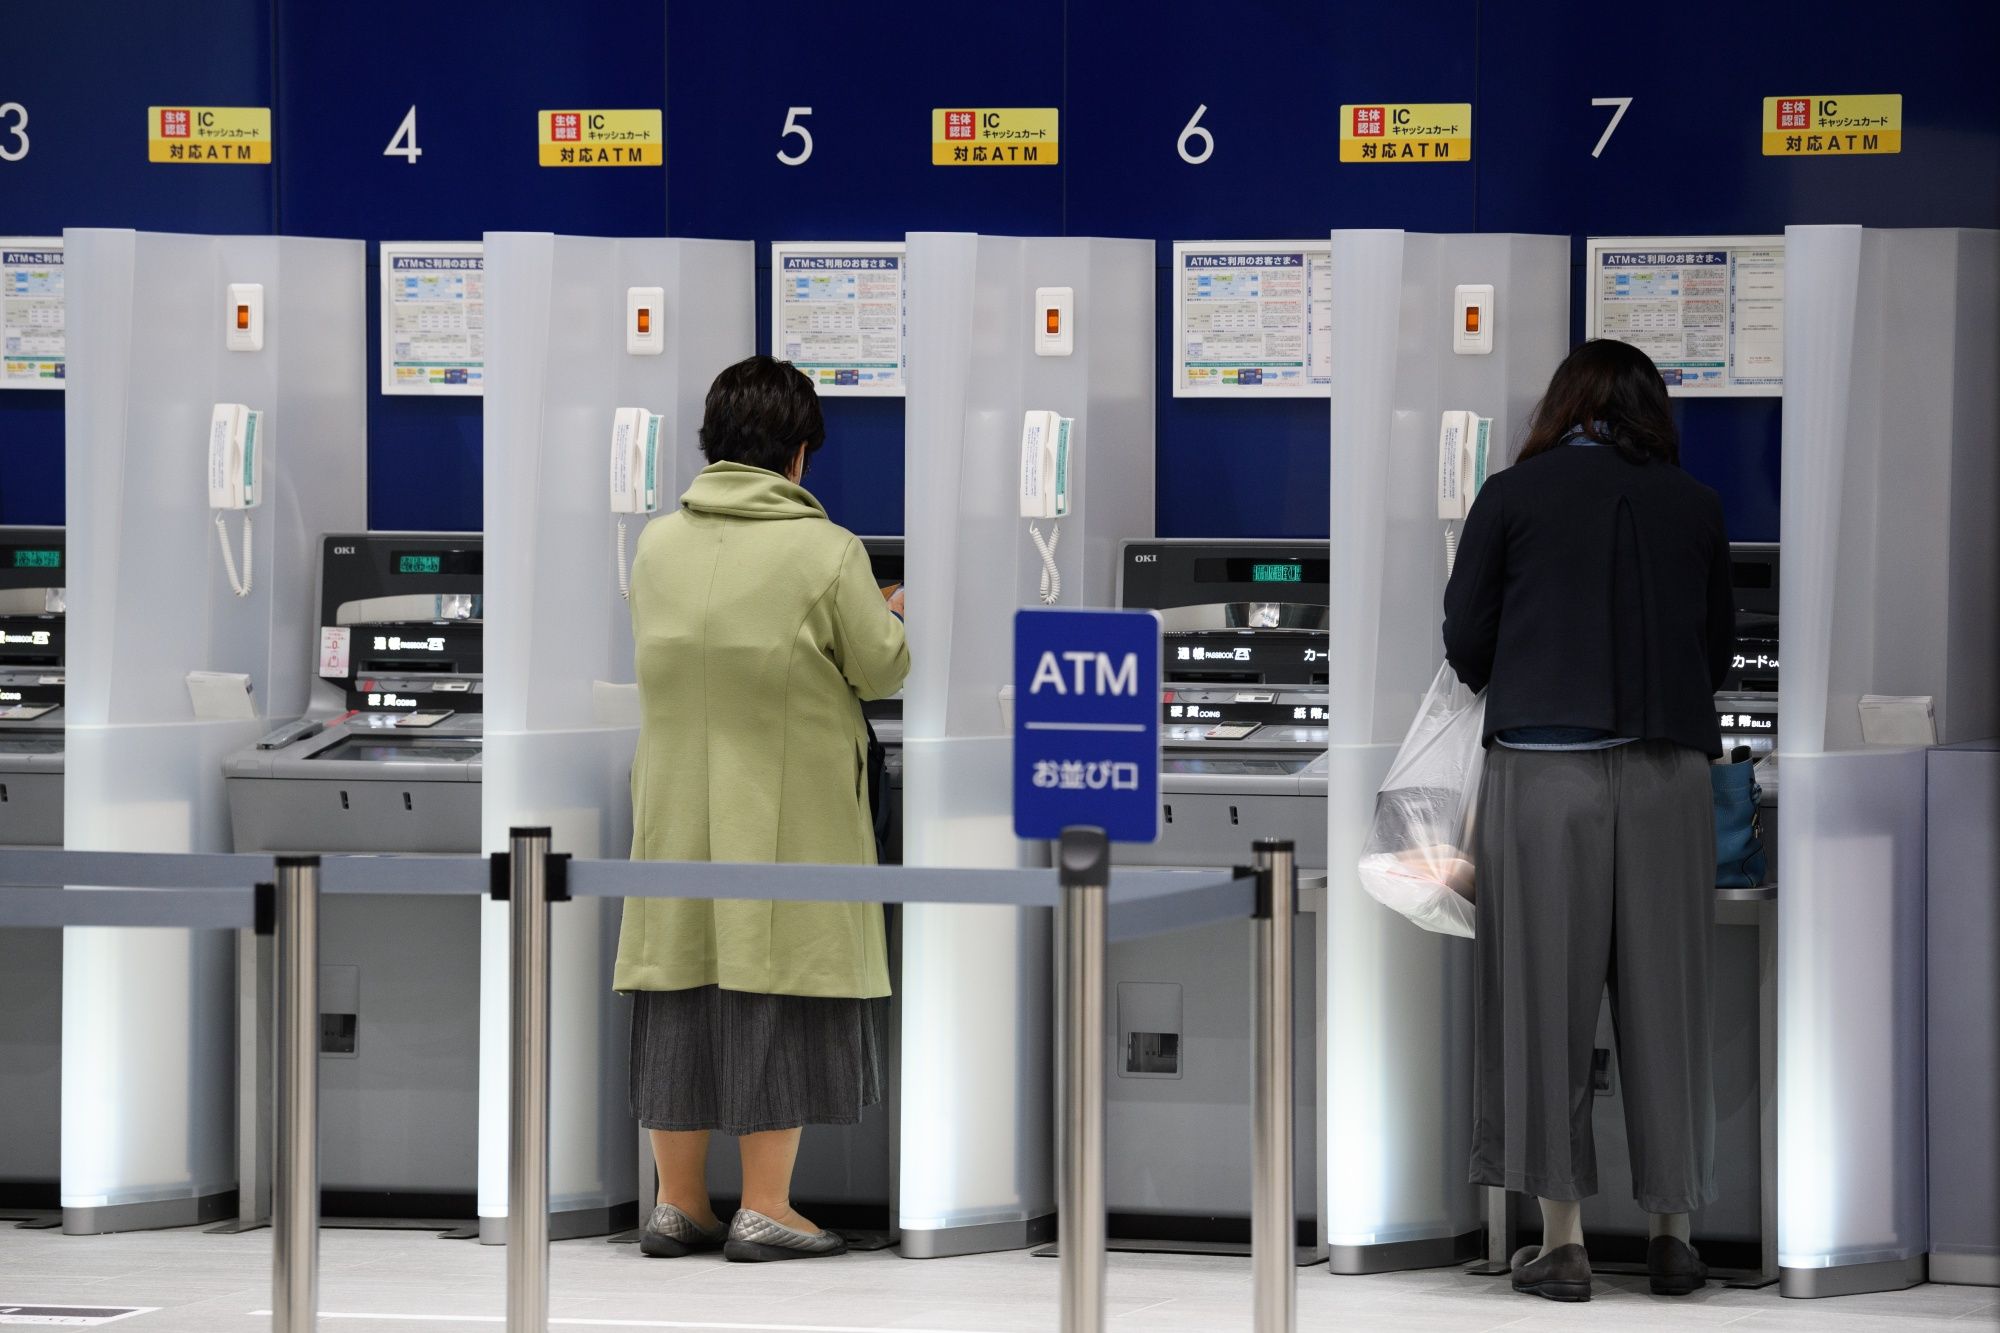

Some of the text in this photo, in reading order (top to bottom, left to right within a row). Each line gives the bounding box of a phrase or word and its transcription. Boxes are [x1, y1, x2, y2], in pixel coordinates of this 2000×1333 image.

[1782, 102, 1805, 113] 生体
[1819, 101, 1837, 116] IC
[165, 111, 186, 123] 生体
[198, 112, 213, 126] IC
[555, 115, 577, 127] 生体
[949, 113, 972, 125] 生体
[984, 113, 999, 128] IC
[1358, 110, 1380, 121] 生体
[1393, 109, 1410, 124] IC
[1782, 115, 1805, 126] 認証
[589, 115, 604, 129] IC
[1358, 122, 1380, 133] 認証
[1592, 98, 1633, 158] 7
[1819, 117, 1887, 127] キャッシュカード
[0, 103, 29, 161] 3
[165, 124, 186, 135] 認証
[198, 128, 259, 137] キャッシュカード
[384, 106, 422, 163] 4
[556, 127, 576, 139] 認証
[588, 130, 651, 140] キャッシュカード
[950, 126, 971, 137] 認証
[983, 129, 1046, 139] キャッシュカード
[1177, 104, 1214, 164] 6
[1393, 125, 1457, 135] キャッシュカード
[777, 107, 812, 165] 5
[8, 254, 64, 263] ATMをご利用
[788, 258, 894, 269] ATMをご利用のお客さまへ
[1190, 255, 1298, 266] ATMをご利用のお客さまへ
[1607, 254, 1721, 265] ATMをご利用のお客さまへ
[1732, 655, 1767, 668] カード
[1029, 651, 1138, 696] ATM
[1032, 759, 1139, 791] お並び口
